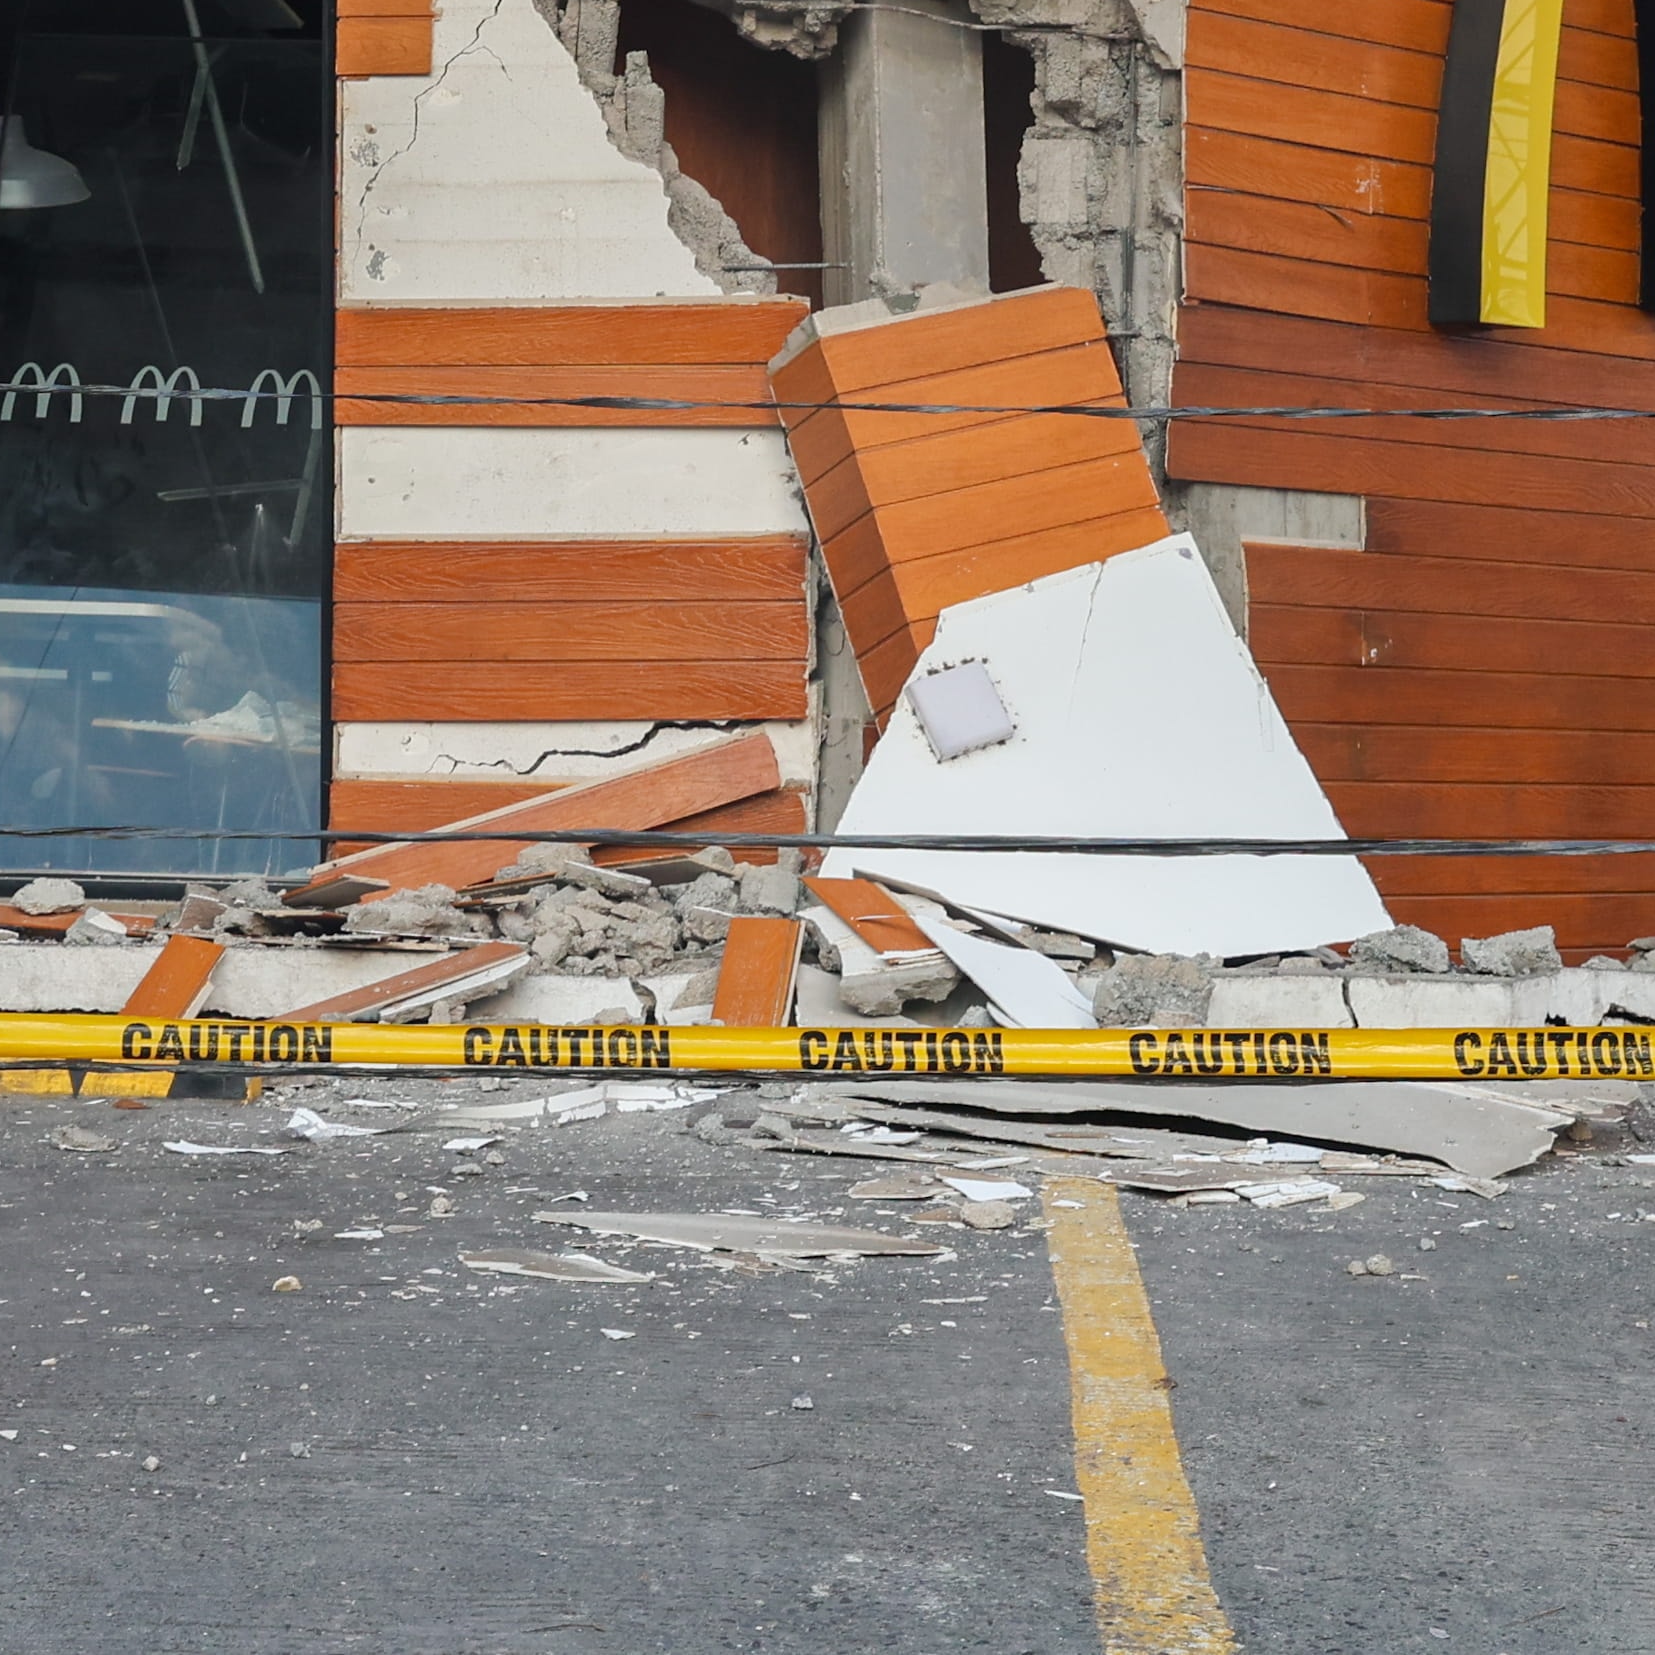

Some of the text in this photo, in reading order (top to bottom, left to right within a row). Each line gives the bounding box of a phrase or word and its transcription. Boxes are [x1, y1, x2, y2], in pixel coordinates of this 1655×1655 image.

[121, 1022, 332, 1062] CAUTION
[463, 1026, 671, 1068] CAUTION
[799, 1029, 1004, 1072] CAUTION
[1128, 1031, 1331, 1075] CAUTION
[1454, 1031, 1655, 1076] CAUTION
